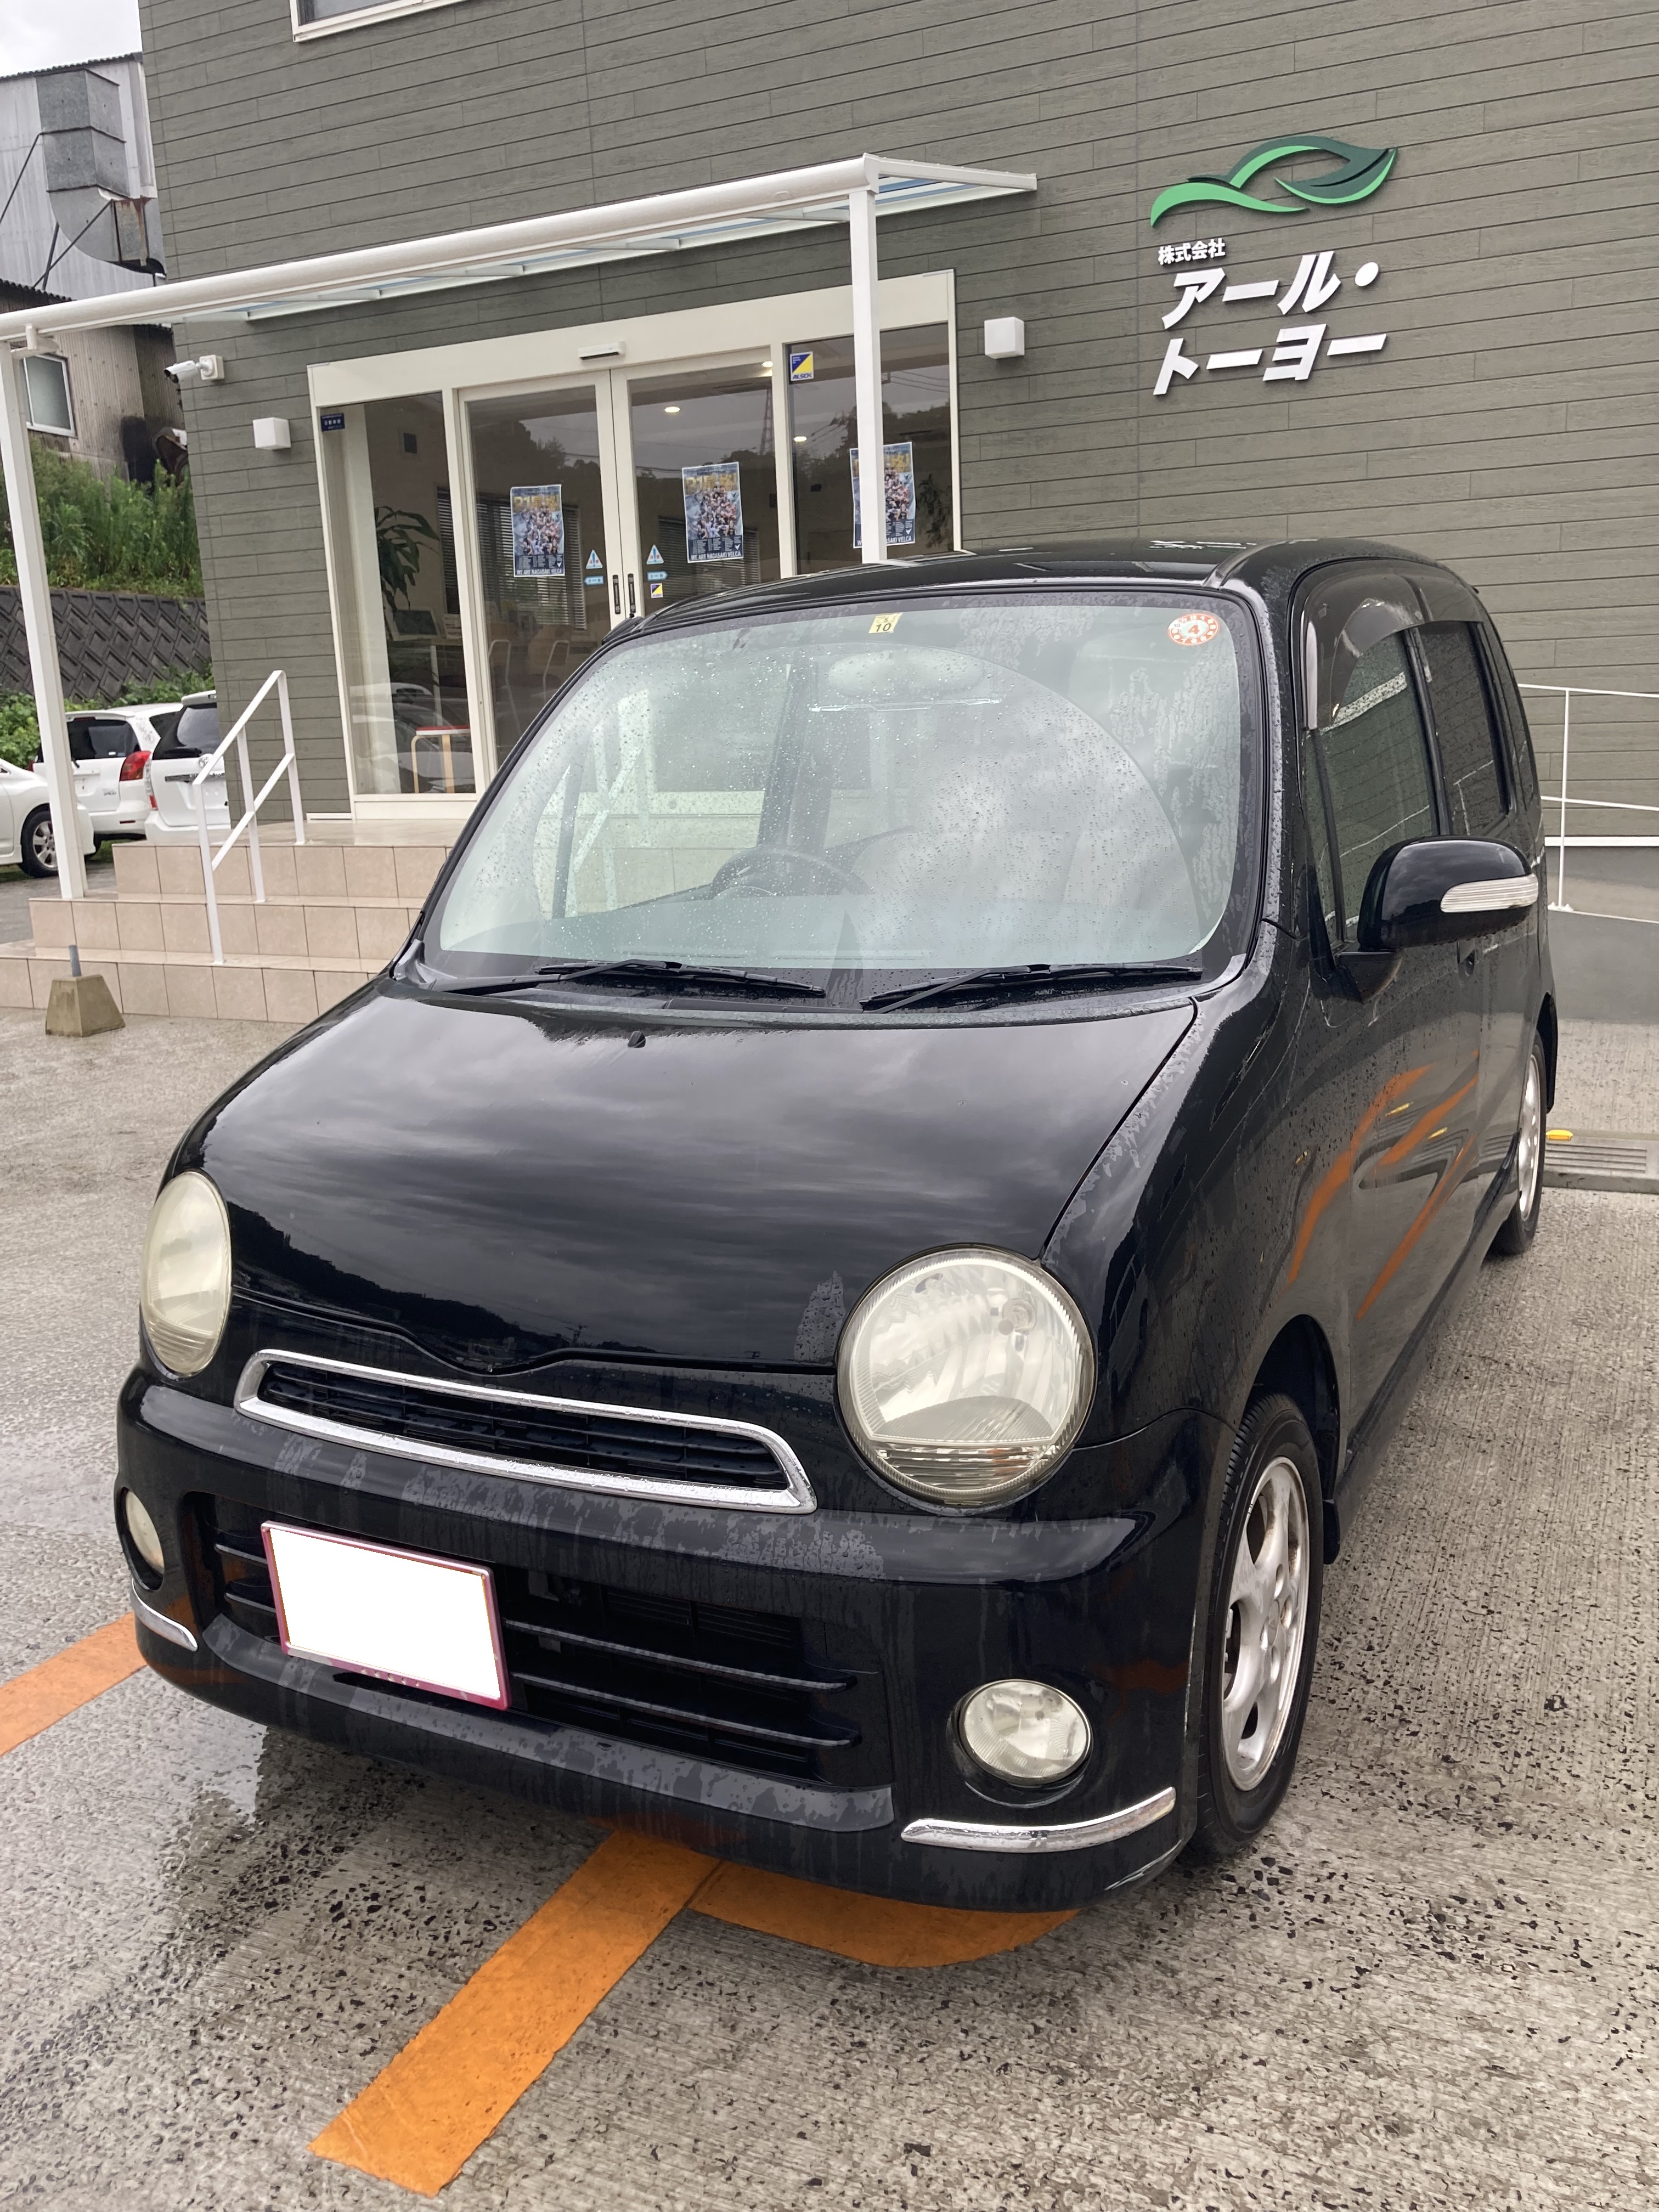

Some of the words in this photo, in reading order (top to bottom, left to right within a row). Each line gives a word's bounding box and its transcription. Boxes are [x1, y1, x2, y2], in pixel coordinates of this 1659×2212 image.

[1158, 238, 1226, 265] 株式会社
[1161, 251, 1379, 329] アール・
[1153, 324, 1387, 396] トーヨー
[876, 623, 891, 632] 10
[1188, 624, 1199, 634] 4
